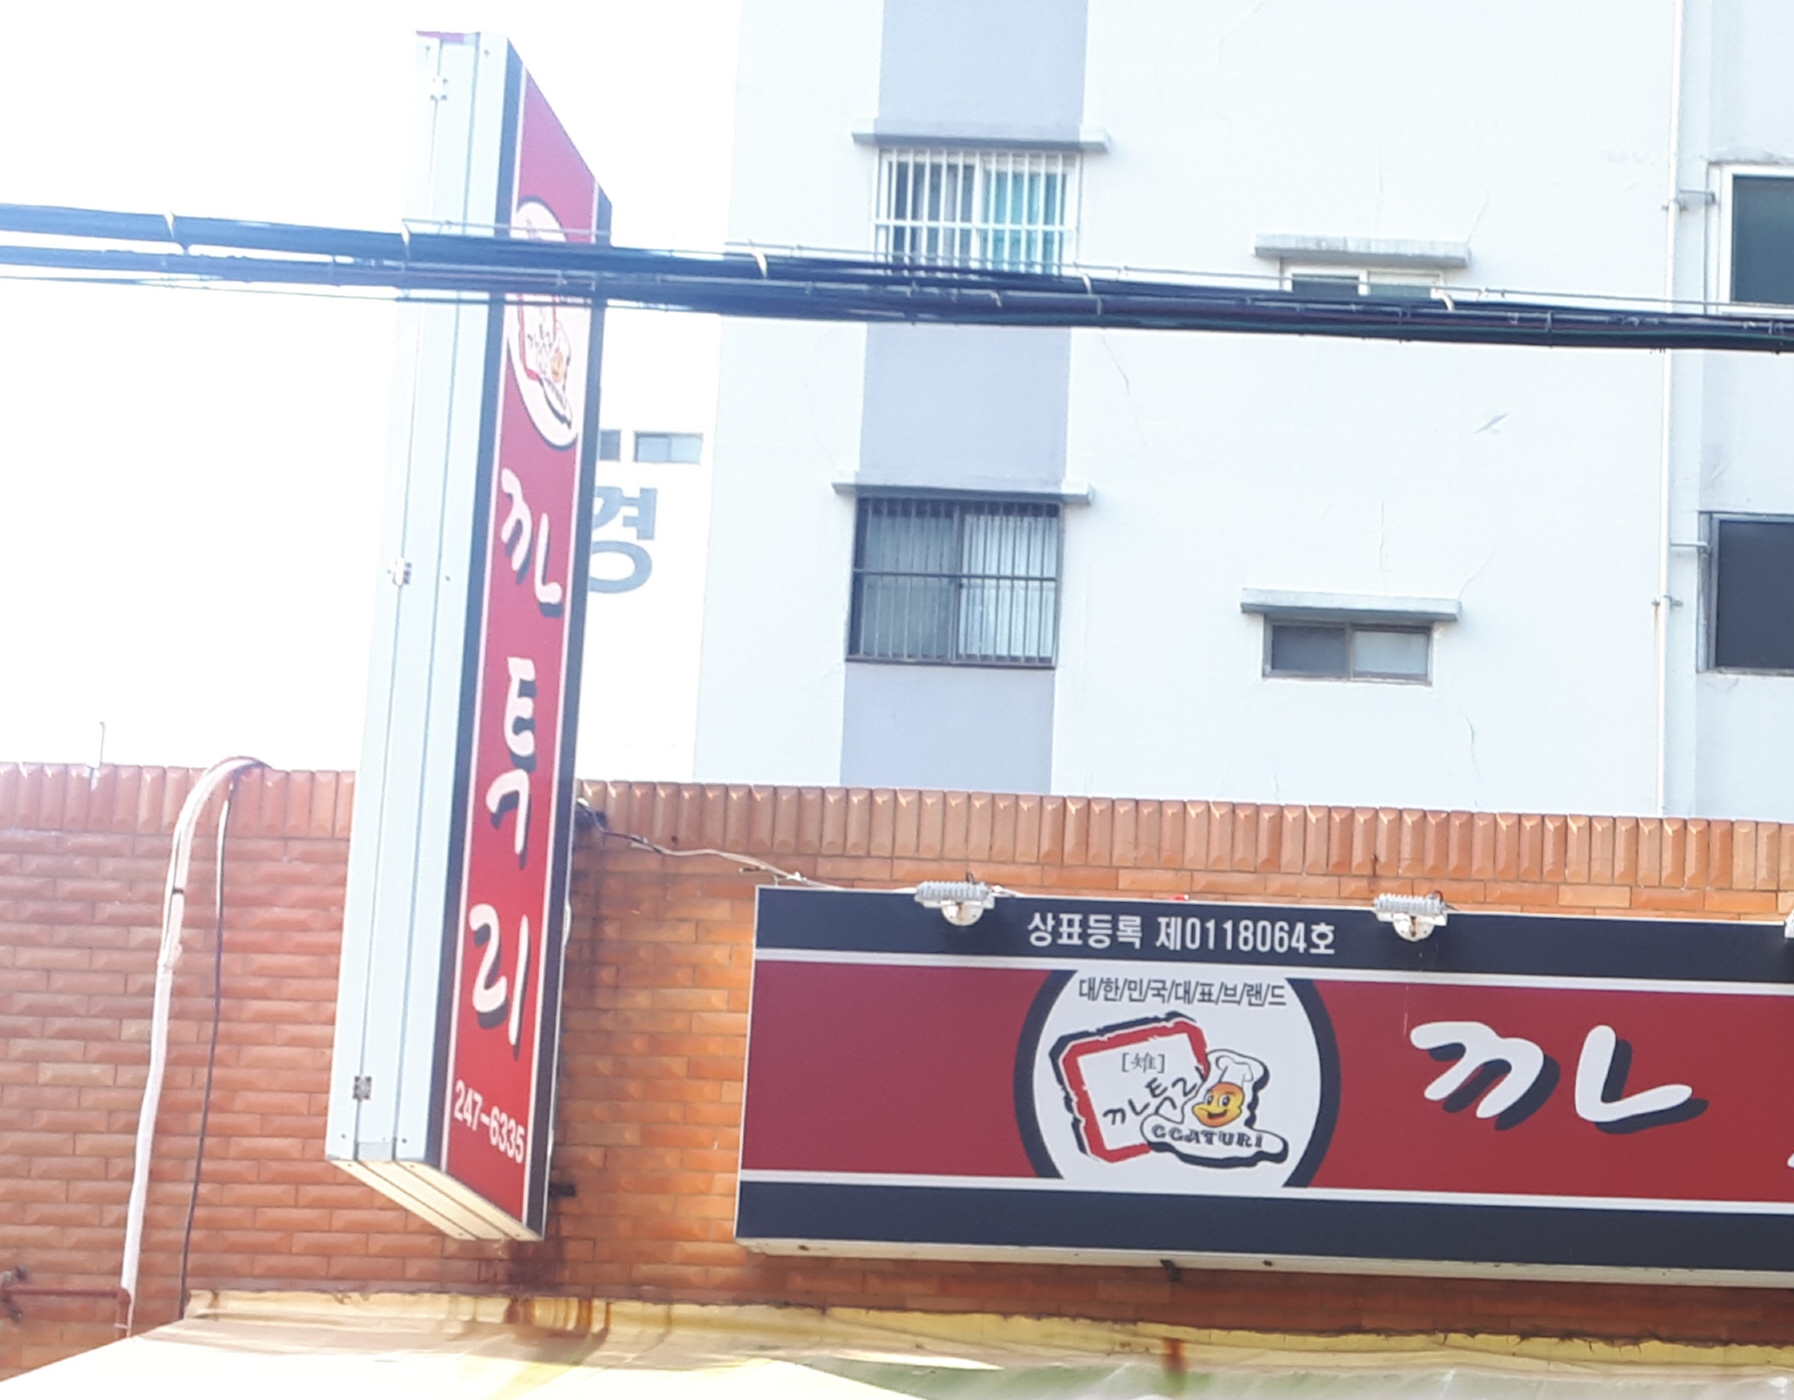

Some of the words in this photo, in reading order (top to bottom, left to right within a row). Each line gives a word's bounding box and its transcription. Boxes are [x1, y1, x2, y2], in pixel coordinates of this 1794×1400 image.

[469, 467, 564, 1047] 까투리
[1027, 911, 1143, 950] 상표등록
[1155, 914, 1336, 955] 제0118064호
[454, 1079, 525, 1165] 247-6335
